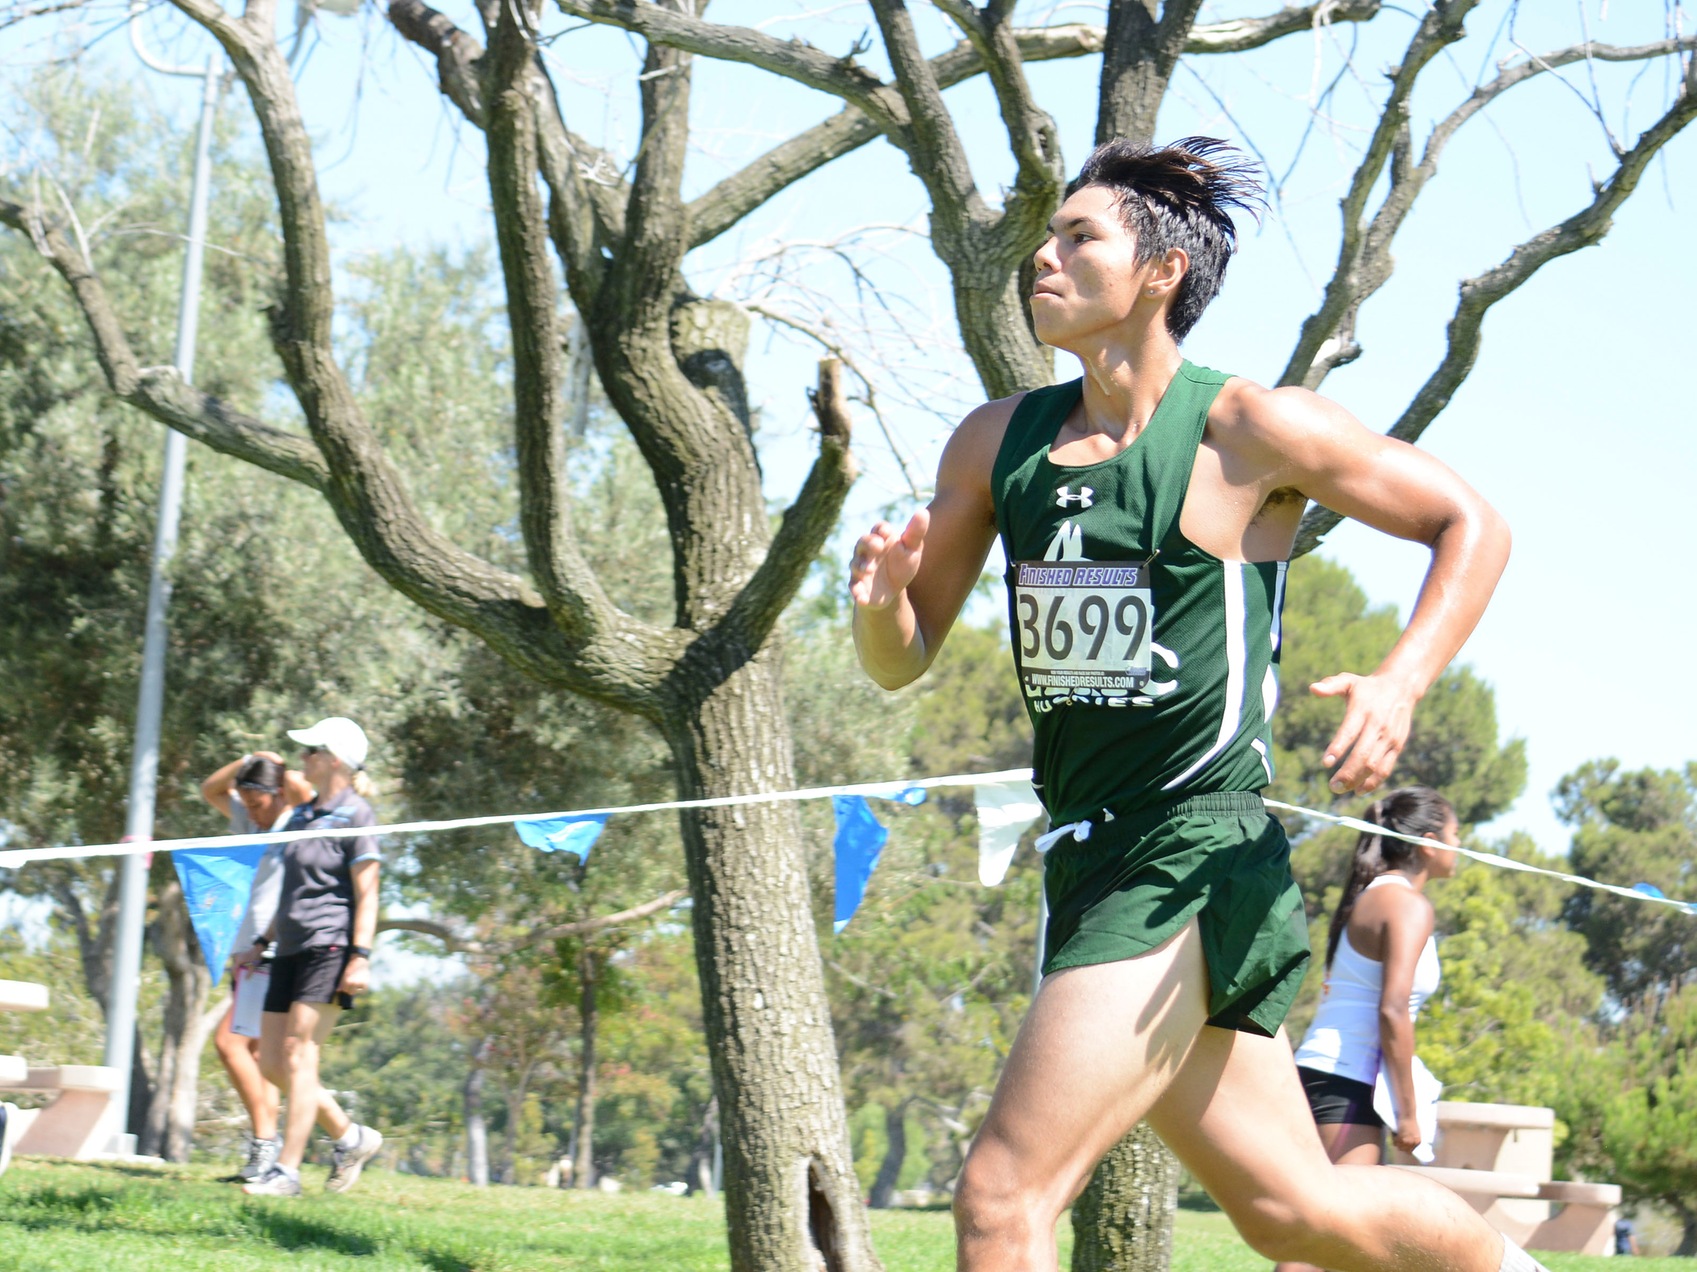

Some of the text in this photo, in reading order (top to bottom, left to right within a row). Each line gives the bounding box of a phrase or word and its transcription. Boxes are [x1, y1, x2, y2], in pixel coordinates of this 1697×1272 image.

[1019, 564, 1138, 587] FINISHED RESULTS
[1019, 594, 1148, 661] 3699
[1031, 673, 1135, 689] WWW.FINISHEDRESULTS.COM
